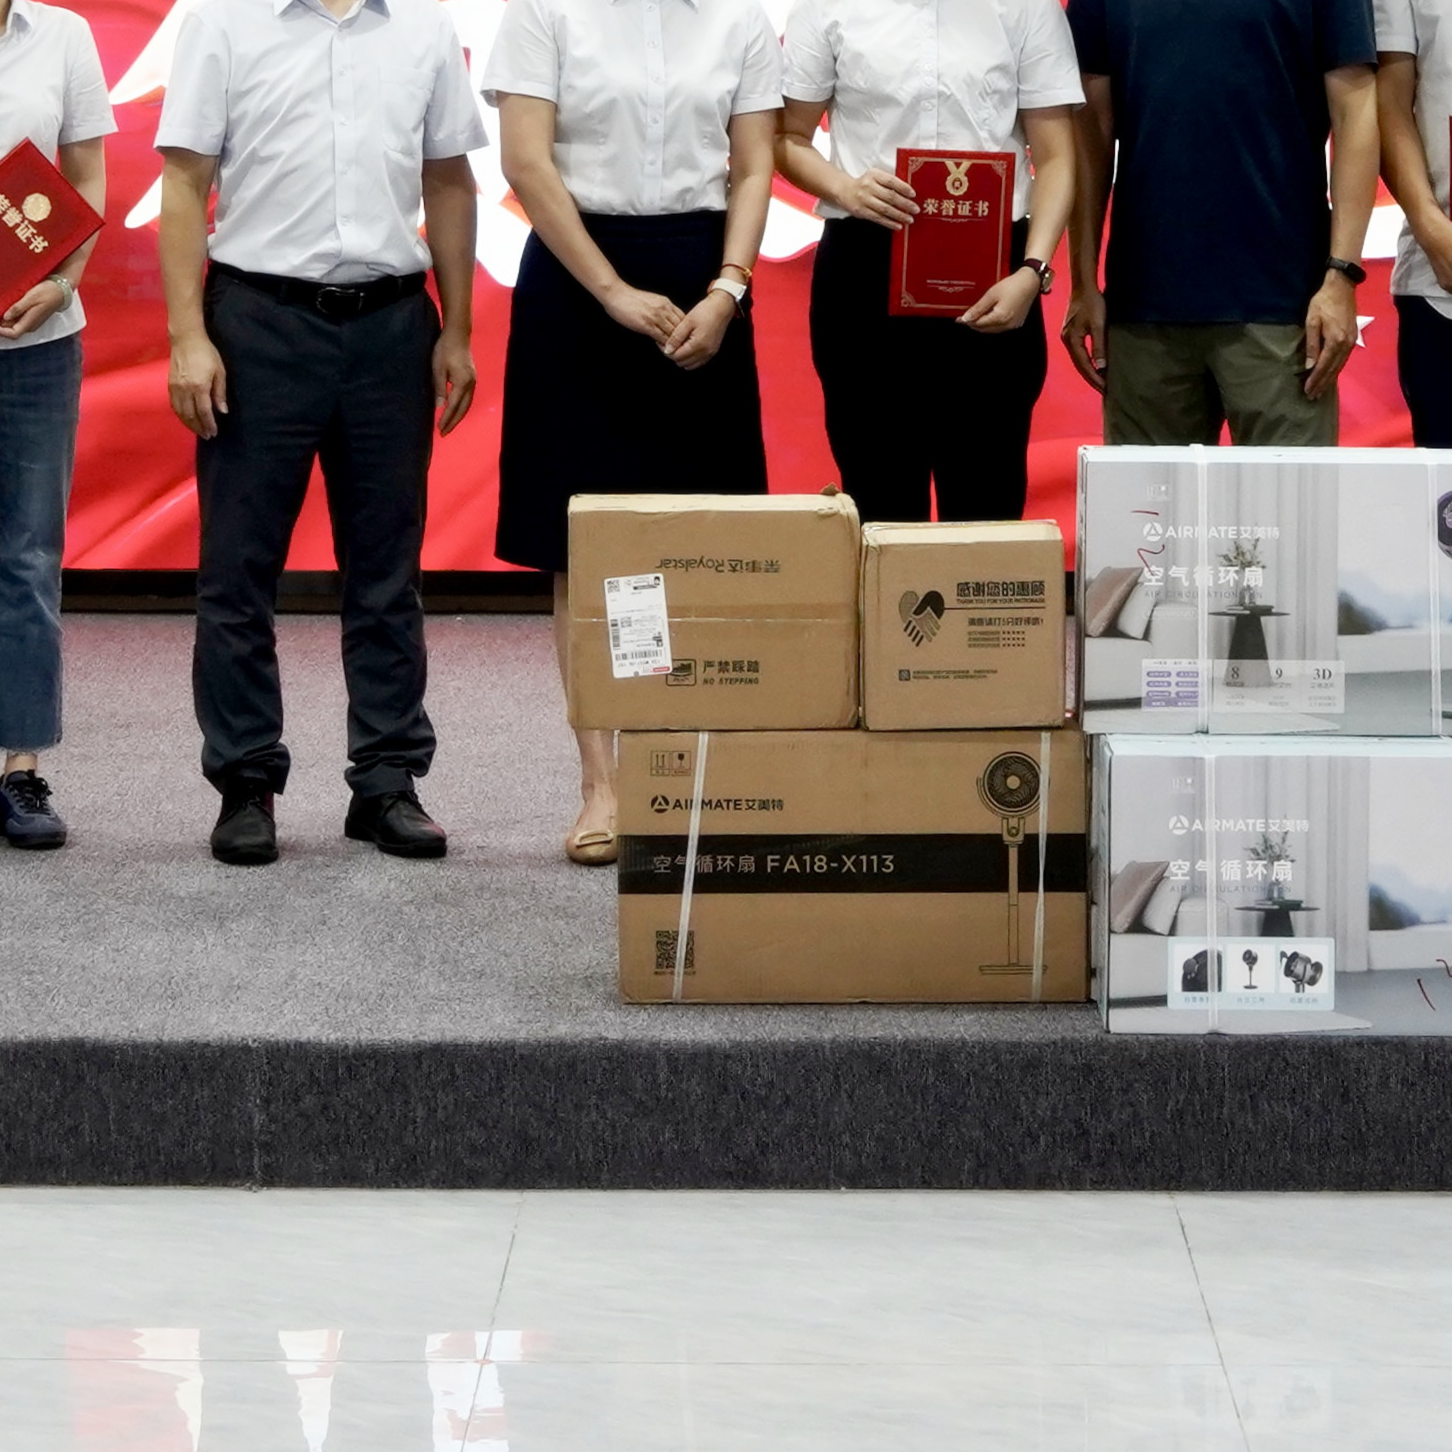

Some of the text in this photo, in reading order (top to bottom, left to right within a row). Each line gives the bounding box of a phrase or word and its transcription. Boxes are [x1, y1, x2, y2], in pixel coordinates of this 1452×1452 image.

[923, 198, 990, 217] 荣誉证书
[655, 555, 725, 573] Royalstar
[956, 580, 1046, 597] 感谢您的惠顾
[702, 660, 759, 674] 严禁踩踏
[1313, 667, 1333, 680] 3D
[702, 677, 759, 686] NO STEPPING
[1191, 819, 1266, 832] ARMATE
[766, 854, 895, 873] FA18-X113
